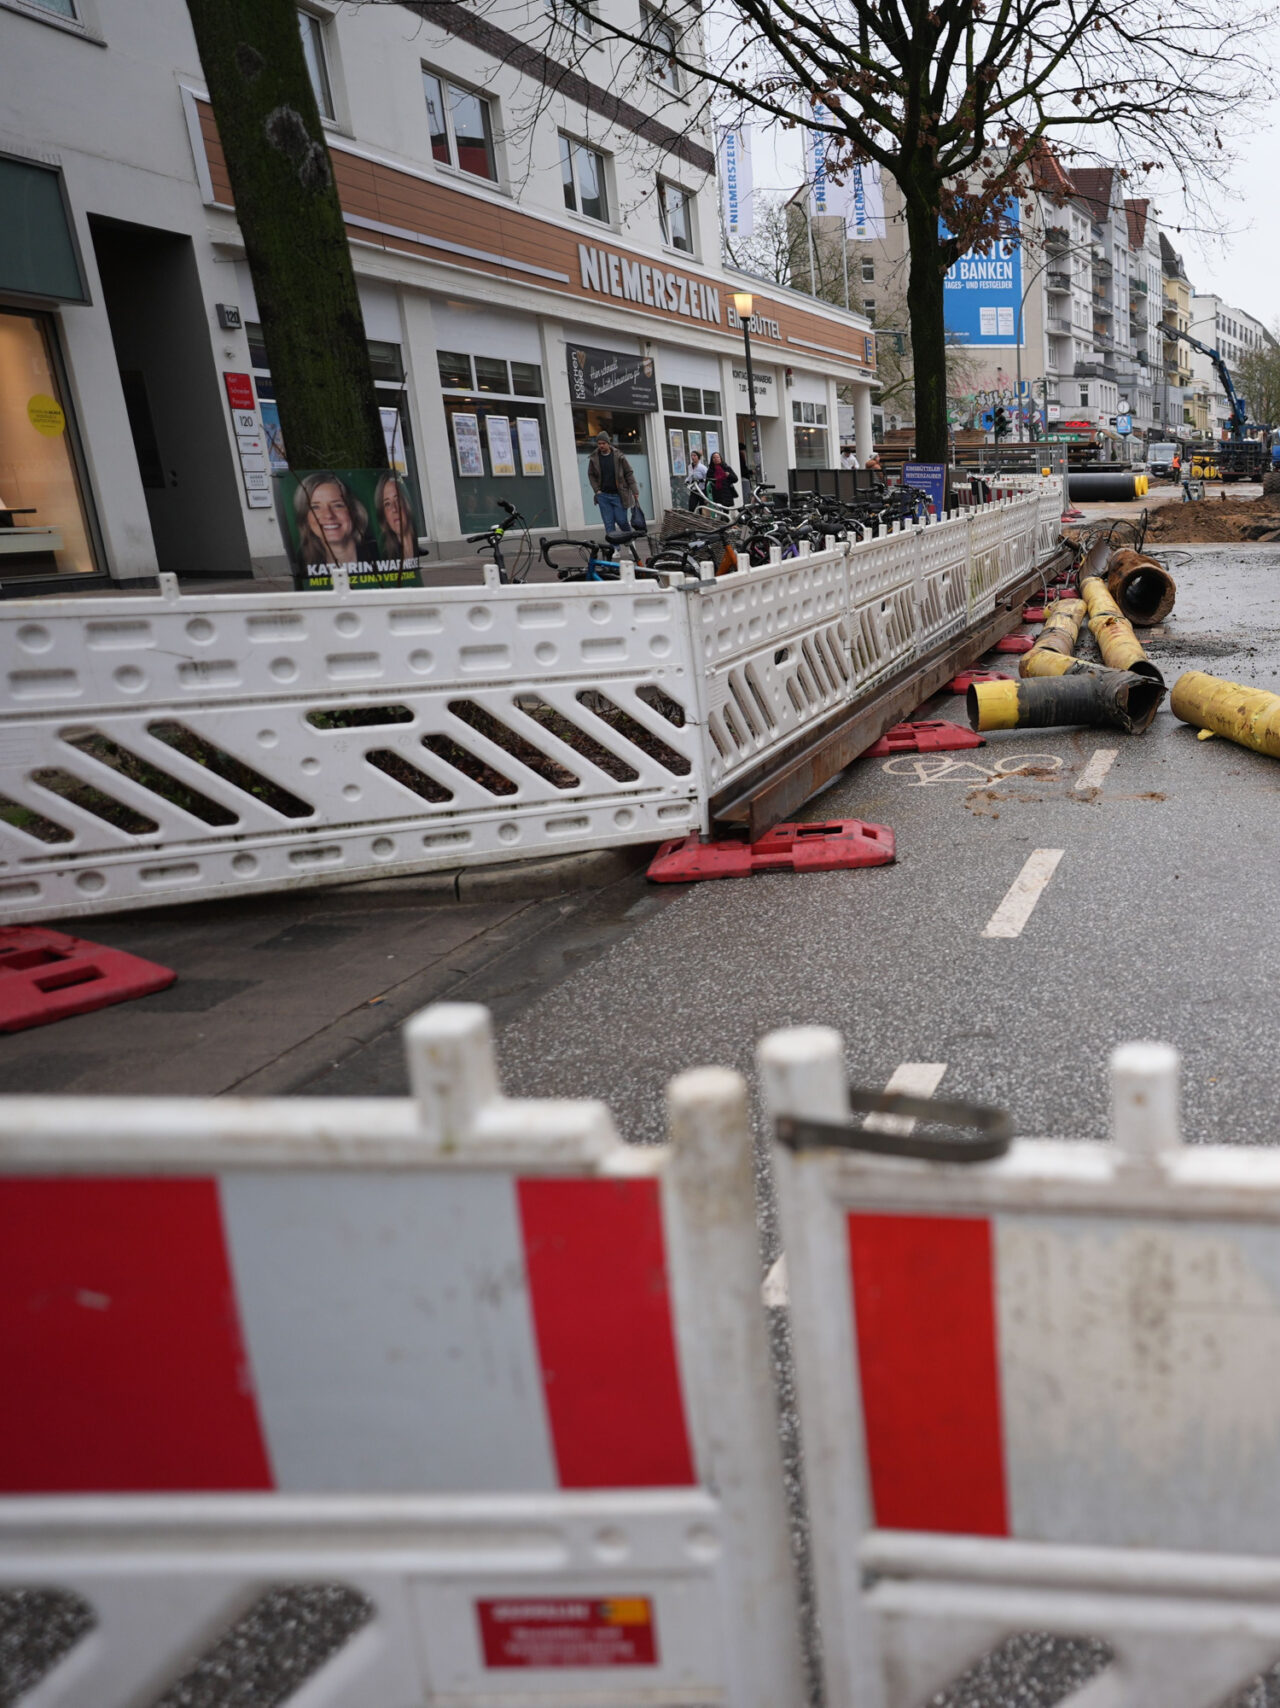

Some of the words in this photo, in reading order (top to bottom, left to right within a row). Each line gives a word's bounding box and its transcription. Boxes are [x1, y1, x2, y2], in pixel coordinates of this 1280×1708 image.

[727, 135, 739, 223] NIEMERSZEIN
[960, 261, 1013, 280] BANKEN
[577, 243, 721, 324] NIEMERSZEIN
[966, 281, 978, 289] UND
[979, 281, 1013, 289] FESTGELDER
[225, 311, 240, 323] 120
[239, 416, 254, 427] 120
[309, 576, 328, 587] MIT
